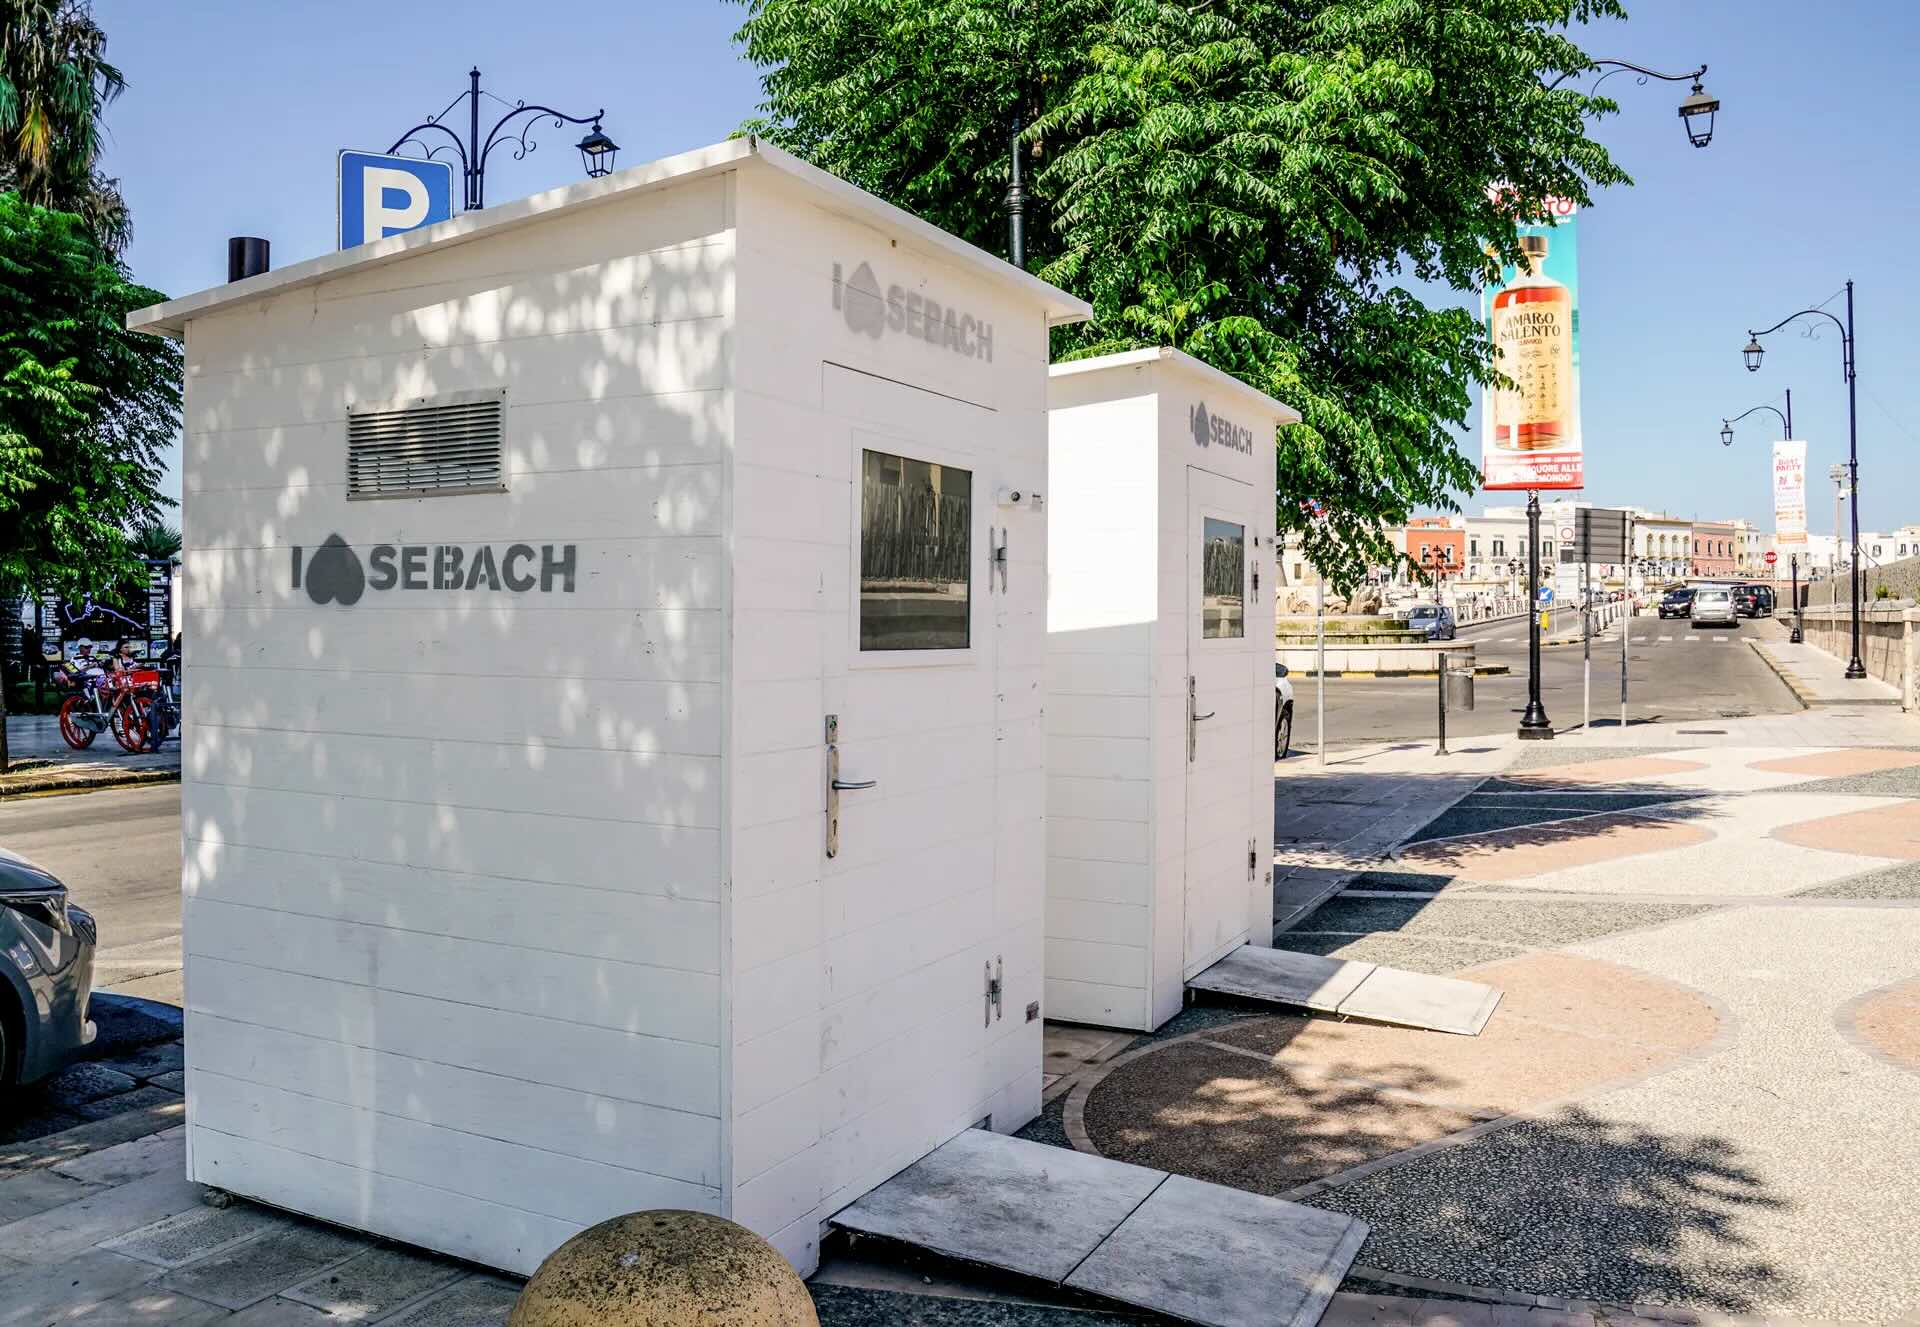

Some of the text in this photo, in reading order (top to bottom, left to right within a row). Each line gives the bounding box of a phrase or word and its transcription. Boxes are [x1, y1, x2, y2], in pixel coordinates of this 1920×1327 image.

[363, 166, 429, 243] P
[886, 284, 993, 363] SEBACH
[1500, 325, 1560, 341] SALENTO
[1506, 312, 1554, 328] AMARO
[1210, 414, 1252, 456] SEBACH
[369, 543, 577, 593] SEBACH
